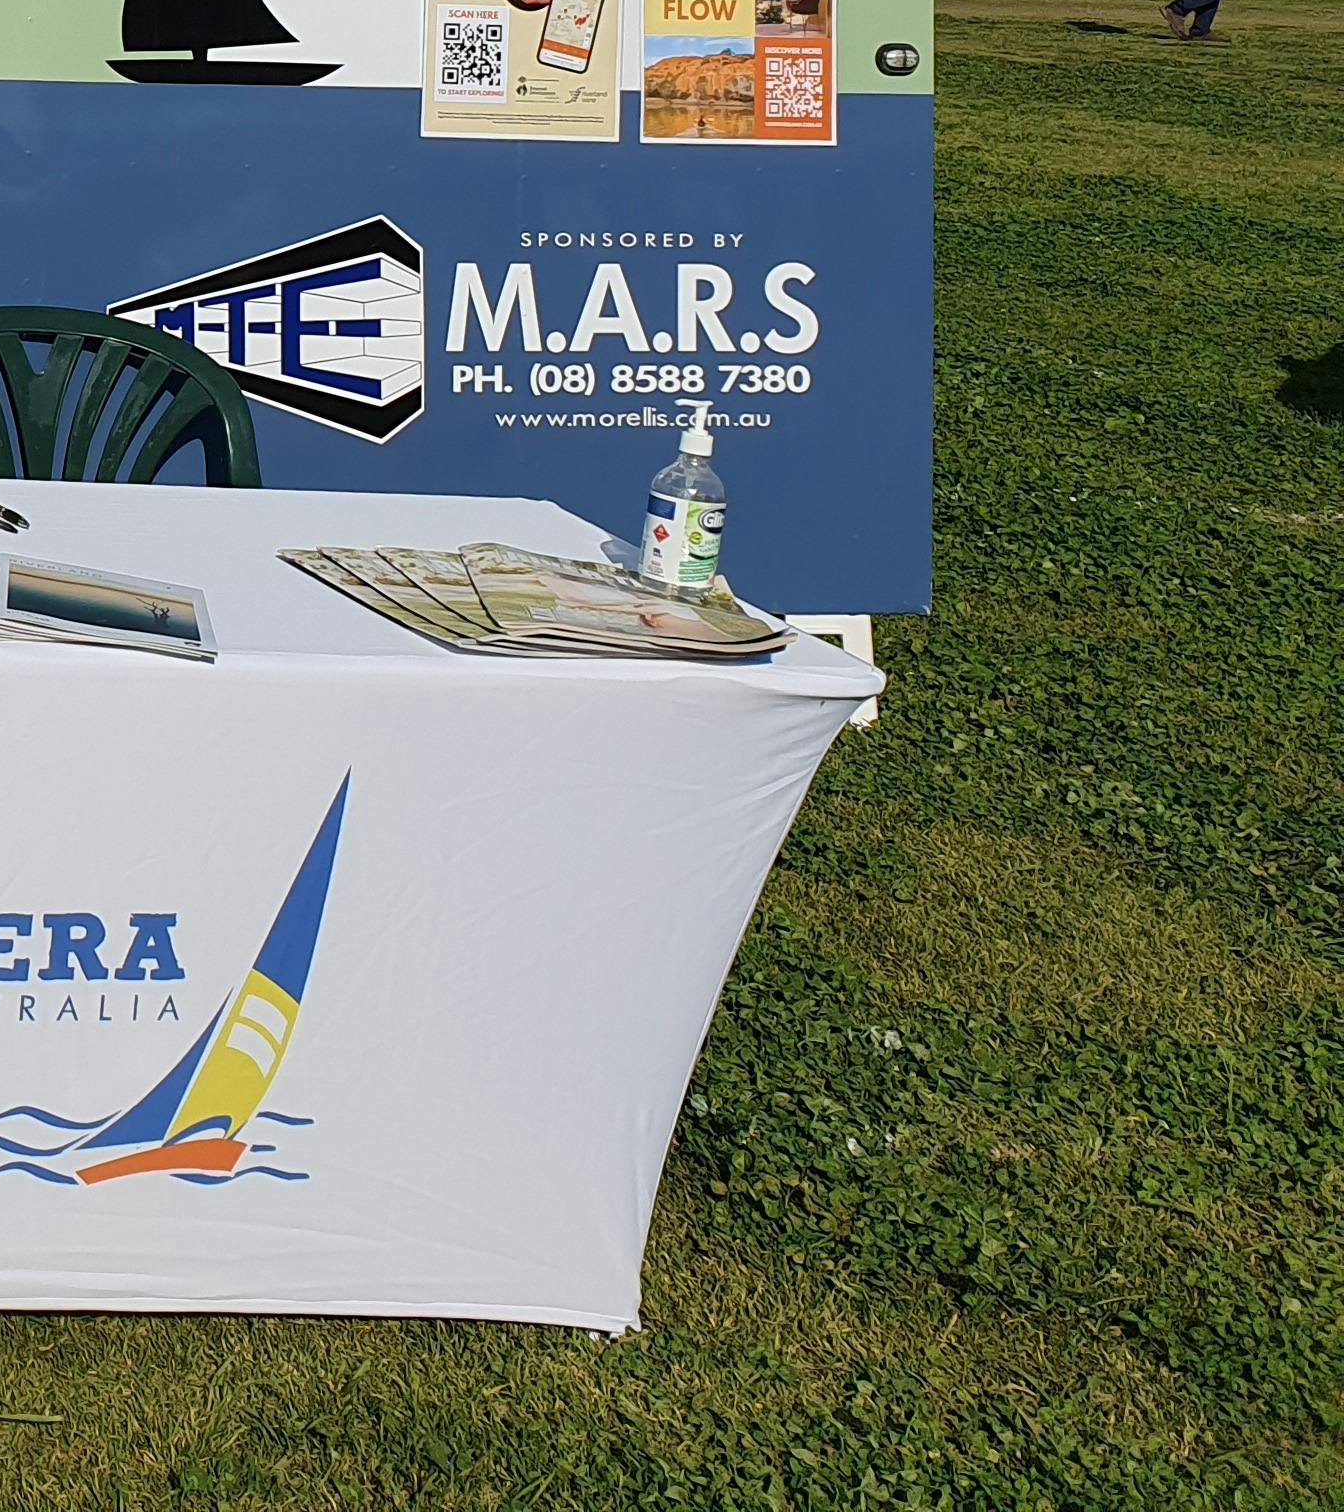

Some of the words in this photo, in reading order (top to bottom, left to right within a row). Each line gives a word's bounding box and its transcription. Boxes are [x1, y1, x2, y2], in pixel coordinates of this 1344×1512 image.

[448, 9, 473, 19] SCAN
[476, 10, 499, 20] HERE
[520, 231, 695, 249] SPONSORED
[714, 232, 745, 249] BY
[445, 261, 820, 356] M.A.R.S
[452, 364, 514, 395] PH.
[529, 363, 597, 396] (08)
[611, 364, 705, 394] 8588
[719, 364, 812, 394] 7380
